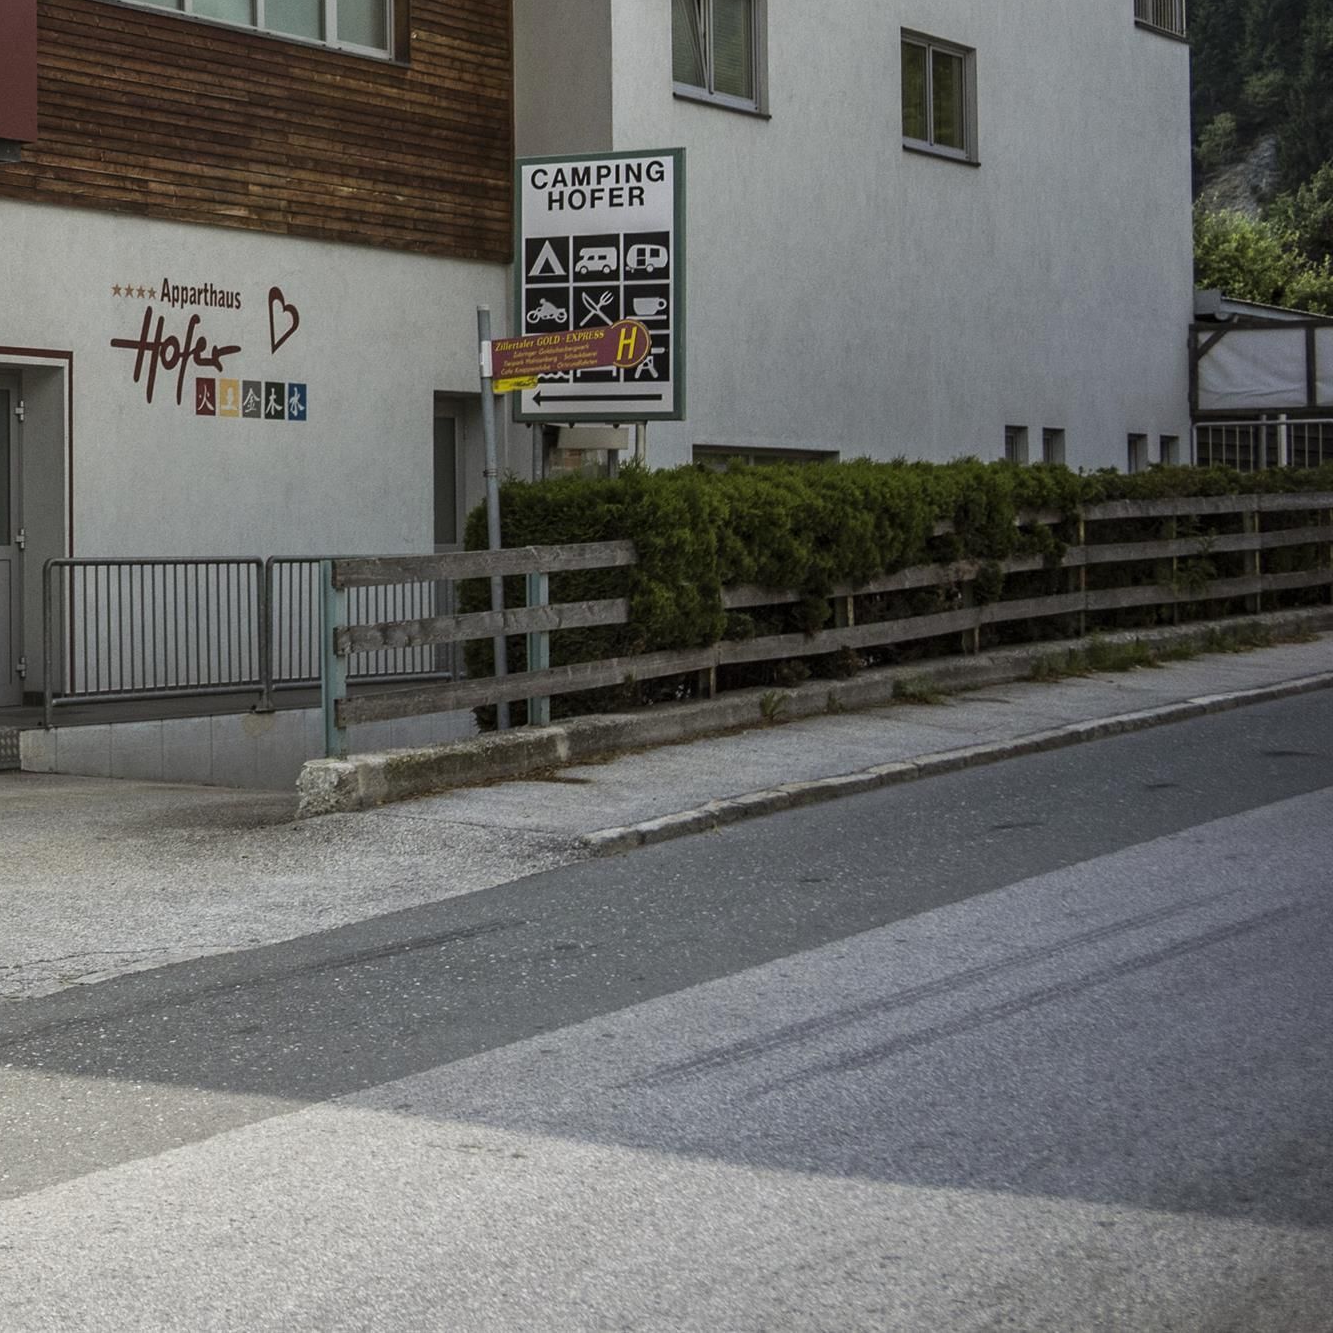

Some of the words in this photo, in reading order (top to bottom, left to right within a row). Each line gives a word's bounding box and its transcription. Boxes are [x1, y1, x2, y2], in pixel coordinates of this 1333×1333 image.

[530, 160, 665, 190] CAMPING
[547, 186, 645, 211] HOFER
[160, 277, 242, 309] Apparthaus
[110, 306, 242, 405] Hofer
[494, 340, 534, 352] Zillertaler
[536, 335, 561, 346] GOLD
[566, 329, 605, 343] EXPRESS
[616, 326, 637, 360] H
[198, 384, 214, 411] 火
[243, 388, 260, 413] 金
[265, 388, 282, 415] 木
